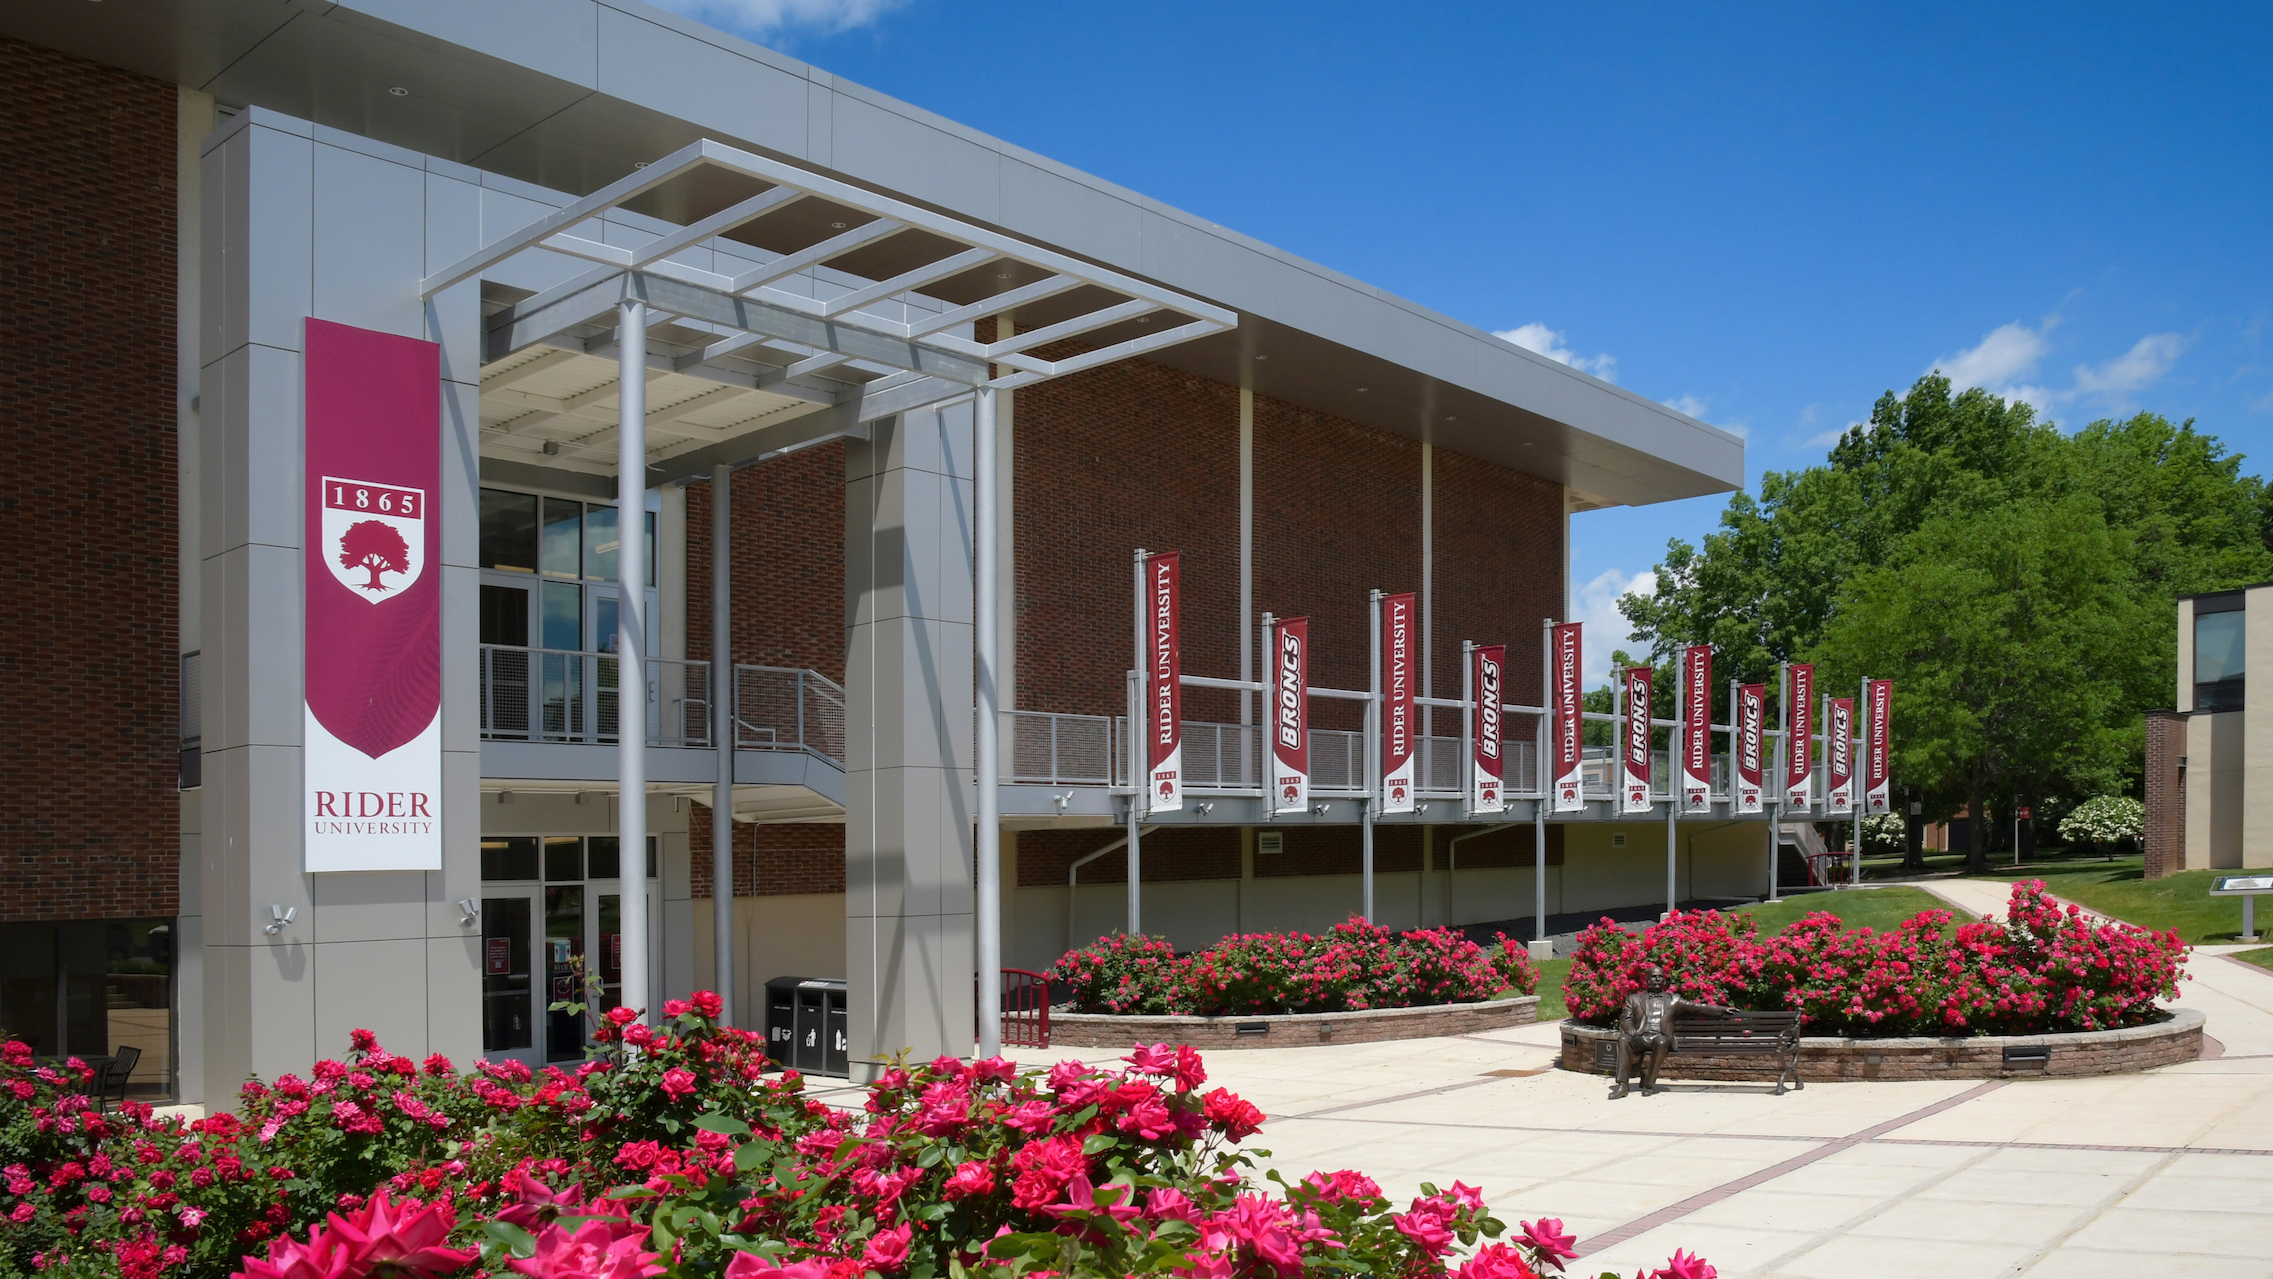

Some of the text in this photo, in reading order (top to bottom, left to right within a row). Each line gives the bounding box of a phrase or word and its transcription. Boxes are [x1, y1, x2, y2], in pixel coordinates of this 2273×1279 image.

[333, 486, 414, 514] 1865
[1158, 563, 1172, 745] RIDER UNIVERSITY
[1279, 630, 1301, 750] BRONCS
[1393, 602, 1406, 757] RIDER UNIVERSITY
[1563, 629, 1575, 763] RIDER UNIVERSITY
[1481, 656, 1500, 760] BRONCS
[1630, 674, 1648, 766] BRONCS
[1693, 651, 1705, 769] RIDER UNIVERSITY
[1743, 690, 1760, 772] BRONCS
[1794, 669, 1807, 774] RIDER UNIVERSITY
[1833, 703, 1849, 777] BRONCS
[1873, 684, 1886, 779] RIDER UNIVERSITY
[314, 791, 433, 818] RIDER
[1157, 772, 1175, 780] 1865
[1281, 777, 1300, 785] 1865
[314, 822, 432, 834] UNIVERSITY
